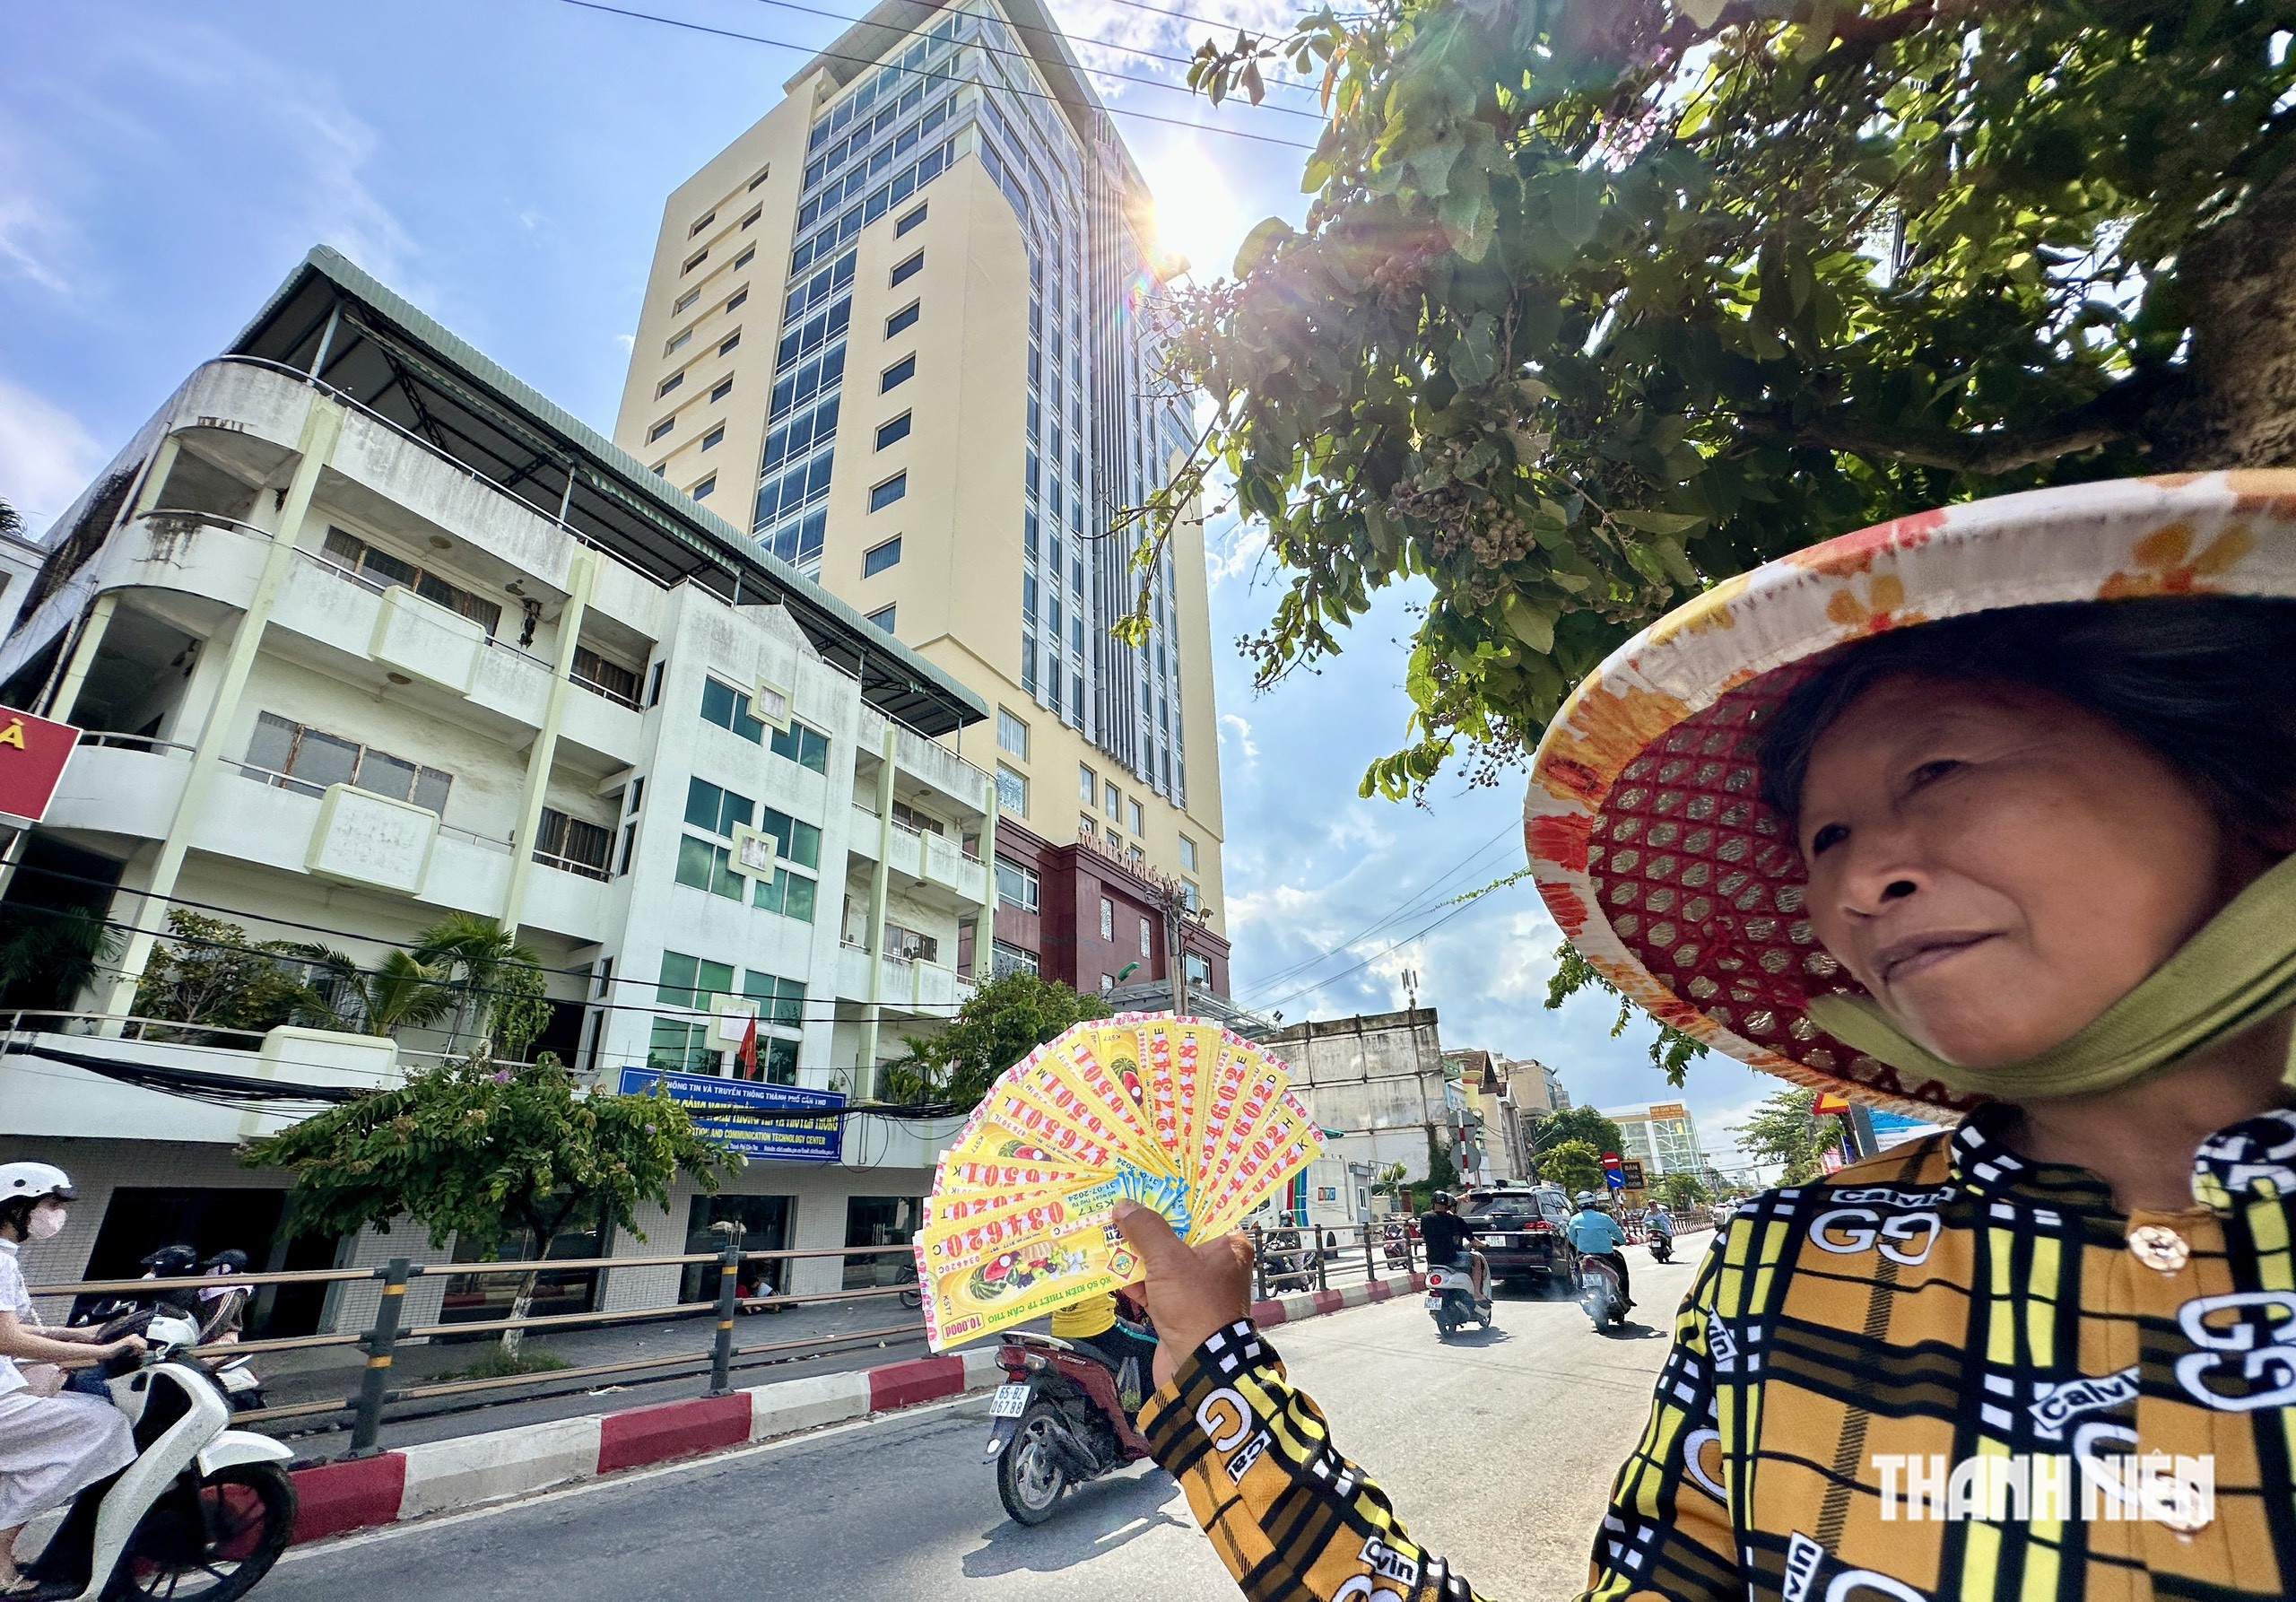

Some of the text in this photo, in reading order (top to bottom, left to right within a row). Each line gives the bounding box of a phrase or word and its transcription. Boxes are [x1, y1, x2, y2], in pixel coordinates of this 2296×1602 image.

[1071, 1043, 1081, 1052] T
[1236, 1055, 1247, 1065] E
[1036, 1067, 1048, 1079] M
[1266, 1074, 1277, 1084] D
[689, 1084, 701, 1092] TIN
[703, 1084, 712, 1093] VÀ
[714, 1085, 741, 1095] TRUYỀN
[743, 1089, 764, 1100] THÔNG
[766, 1092, 787, 1101] THÀNH
[1150, 1027, 1179, 1153] 427348 E
[1004, 1096, 1012, 1106] L
[1283, 1118, 1293, 1128] H
[710, 1127, 723, 1138] AND
[724, 1127, 771, 1142] COMMUNICATION
[771, 1132, 805, 1144] TECHNOLOGY
[805, 1135, 826, 1145] CENTER
[1011, 1098, 1111, 1167] 476501
[1297, 1139, 1309, 1151] K
[953, 1166, 961, 1176] K
[1067, 1181, 1116, 1202] 31-07-2024
[1078, 1198, 1114, 1215] K5T7
[933, 1201, 1064, 1257] 034620 C
